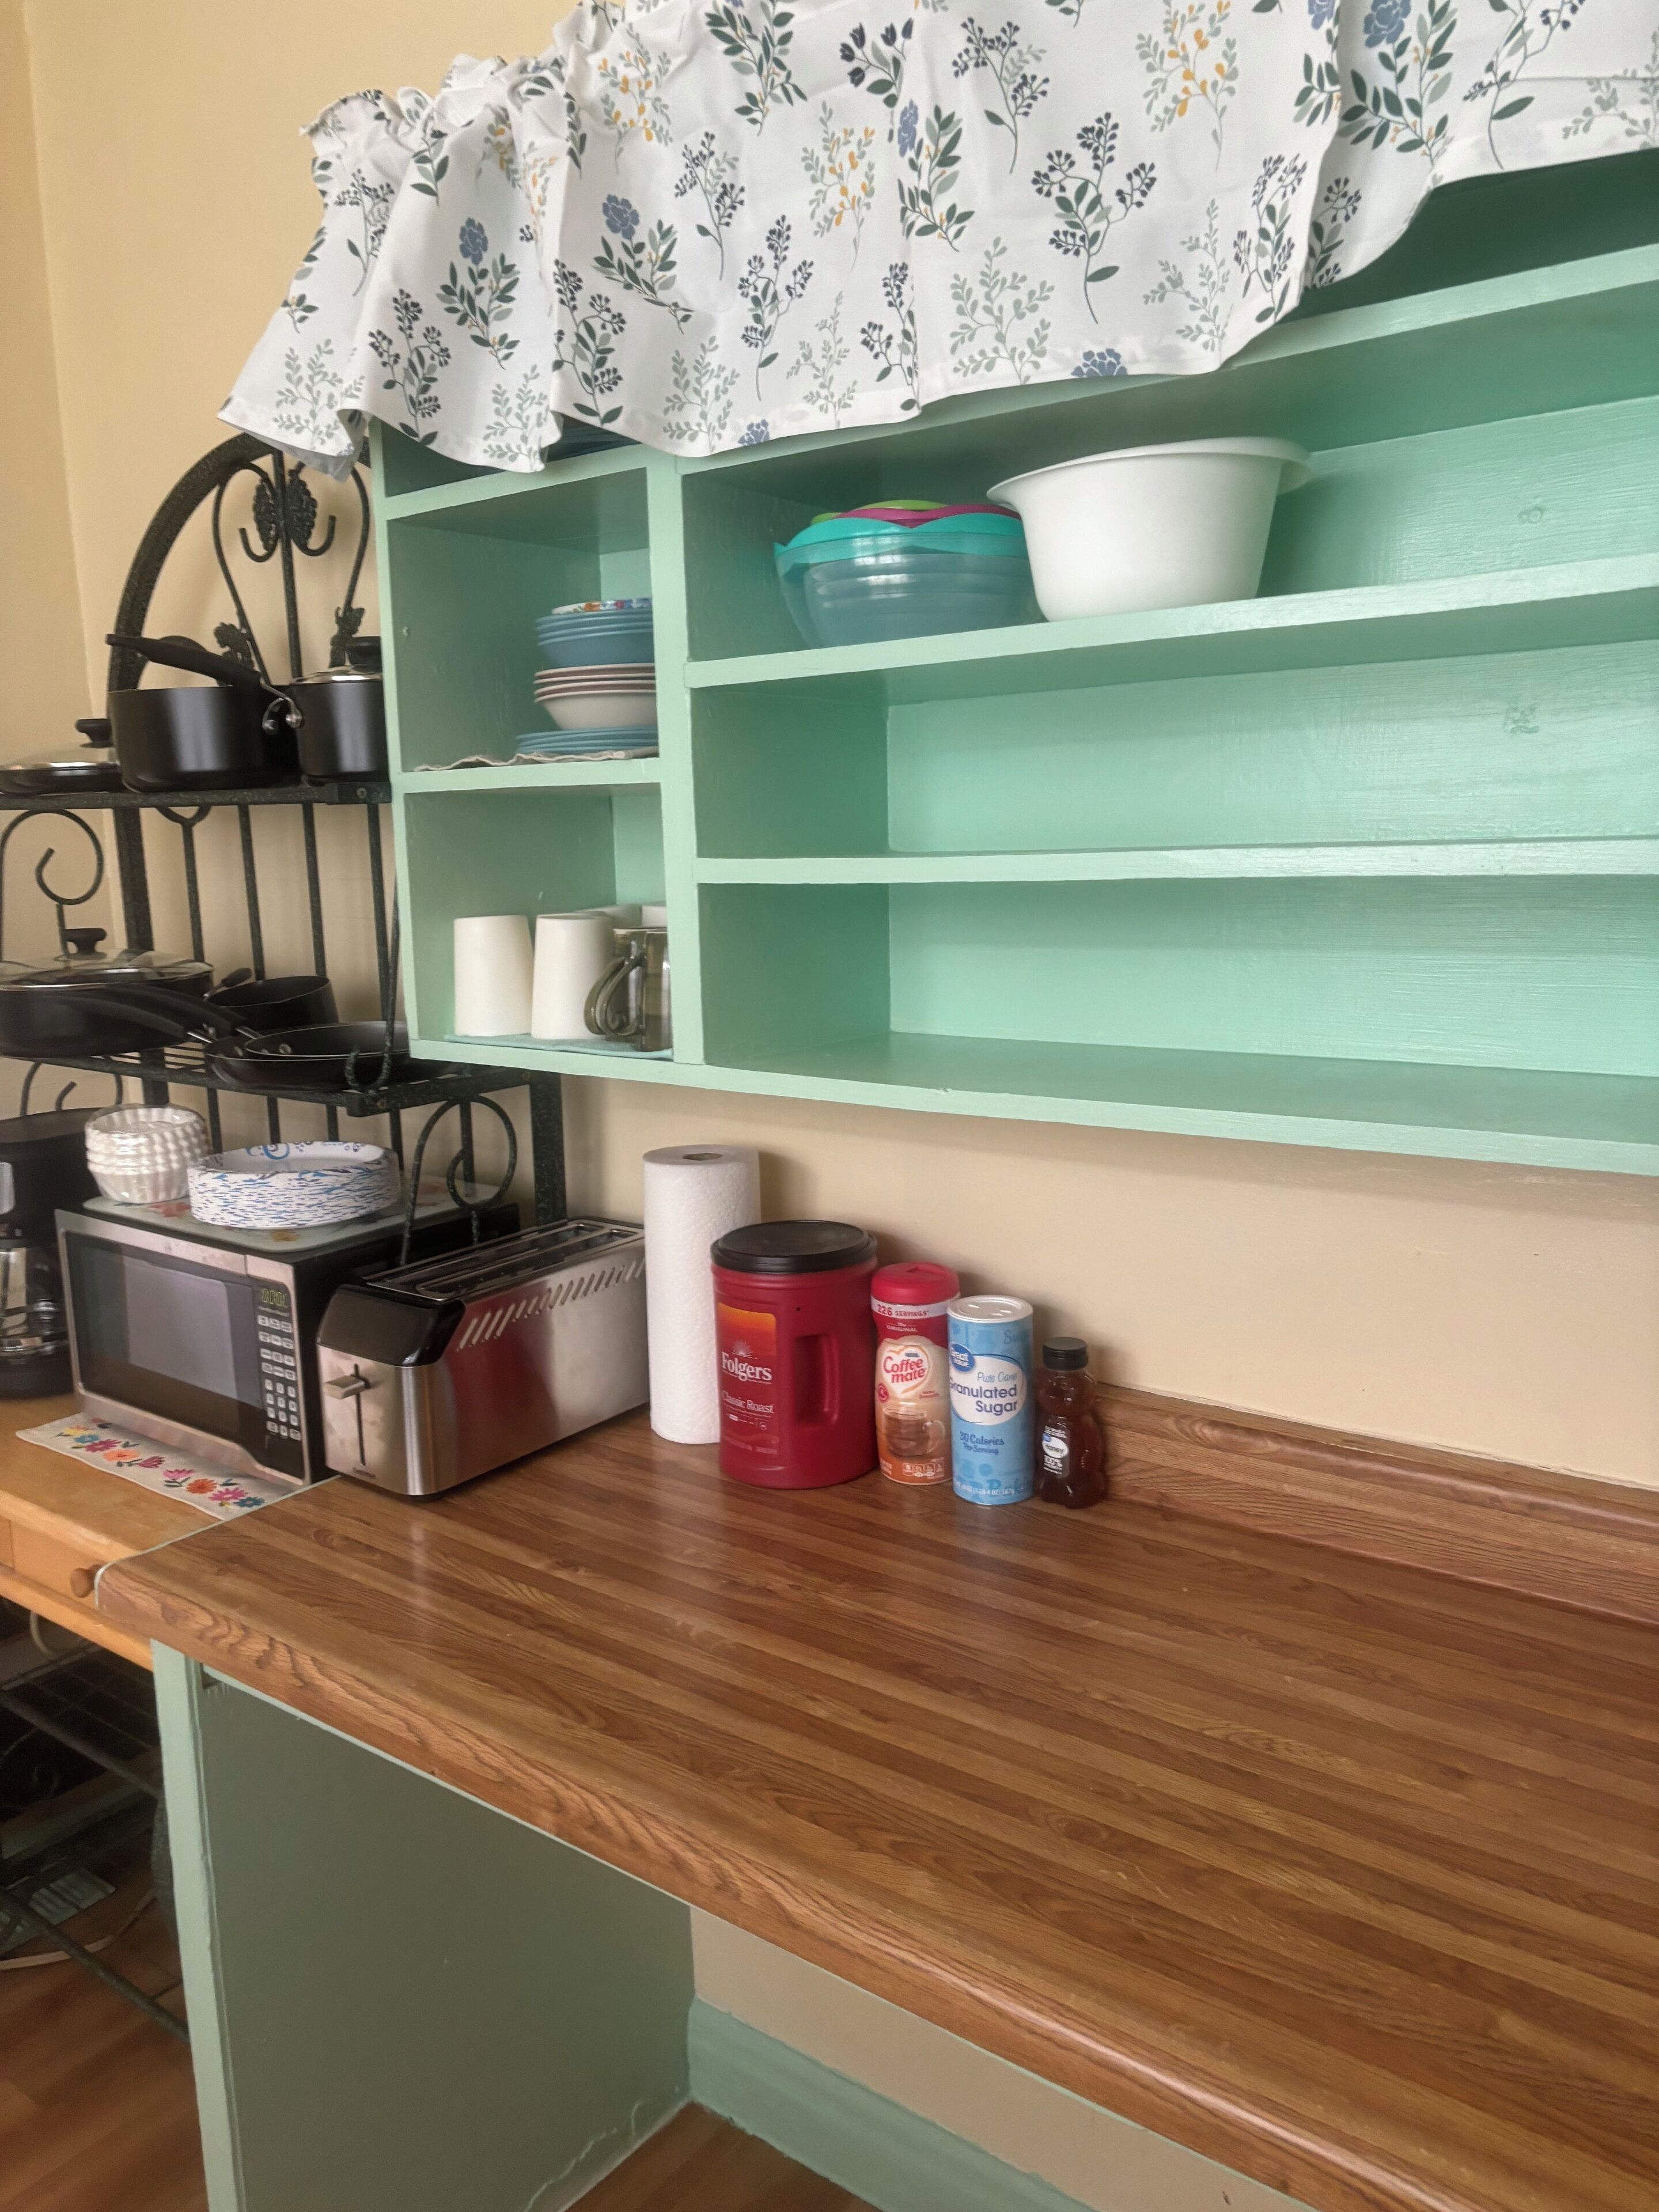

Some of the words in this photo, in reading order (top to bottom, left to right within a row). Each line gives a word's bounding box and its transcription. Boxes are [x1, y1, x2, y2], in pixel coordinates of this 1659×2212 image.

[877, 1304, 893, 1316] 226
[721, 1351, 772, 1381] Folgers
[883, 1355, 923, 1373] Coffee
[891, 1368, 926, 1383] mate
[747, 1399, 775, 1413] Roast
[975, 1400, 1018, 1416] Sugar
[969, 1434, 1005, 1445] Calories
